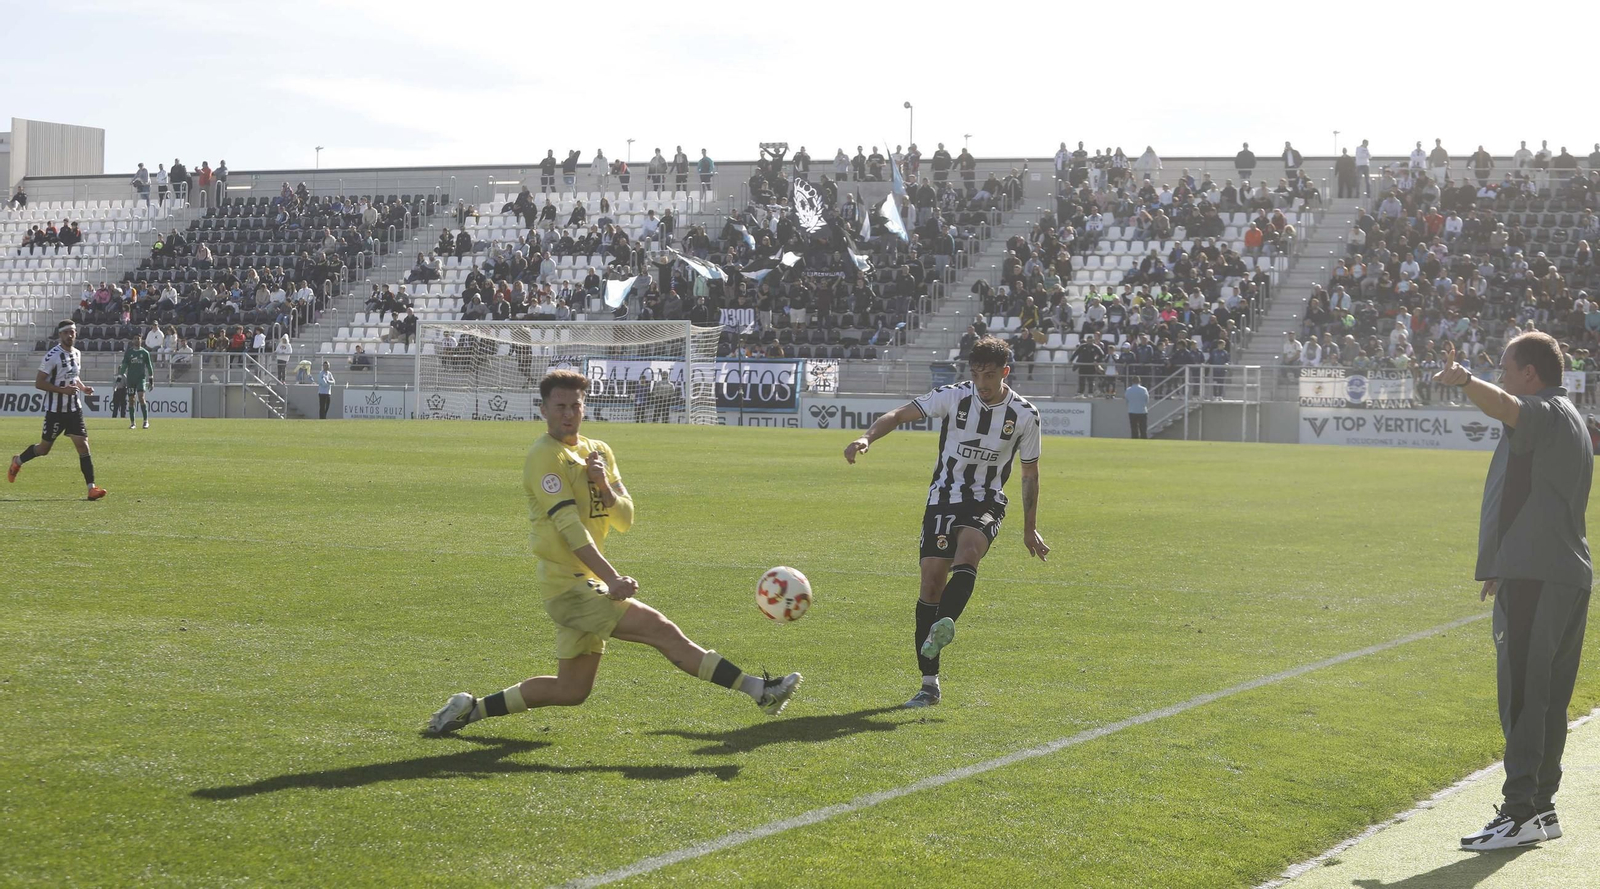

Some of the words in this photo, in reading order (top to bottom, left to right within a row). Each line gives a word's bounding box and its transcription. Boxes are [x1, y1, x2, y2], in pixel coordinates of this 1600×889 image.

[1300, 368, 1346, 377] SIEMPRE
[1367, 370, 1413, 379] BALONA
[1300, 397, 1346, 407] COMANDO
[344, 406, 380, 414] EVENTOS
[383, 407, 403, 415] RUIZ
[53, 422, 59, 432] 5
[1333, 416, 1366, 432] TOP
[1373, 415, 1452, 436] VERTICAL
[957, 444, 999, 462] LOTUS
[934, 514, 957, 534] 17
